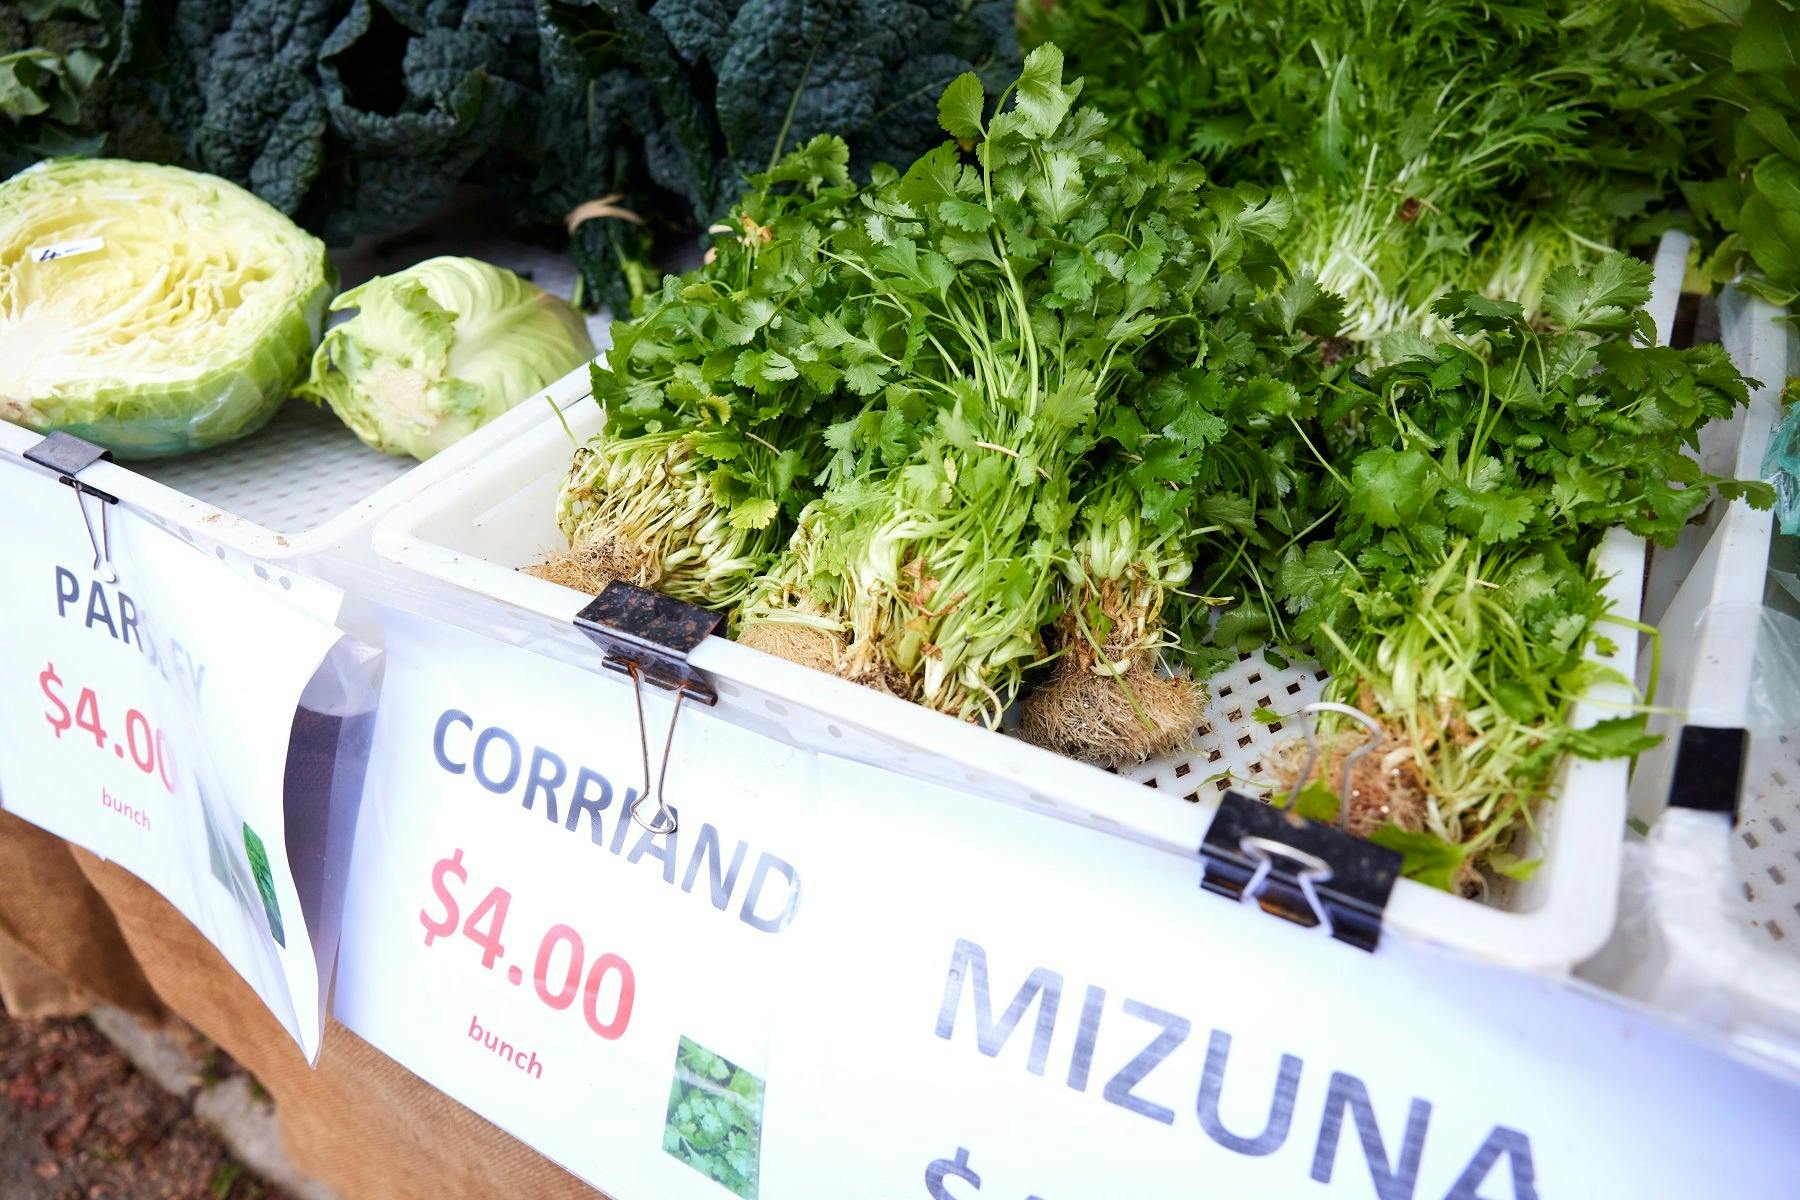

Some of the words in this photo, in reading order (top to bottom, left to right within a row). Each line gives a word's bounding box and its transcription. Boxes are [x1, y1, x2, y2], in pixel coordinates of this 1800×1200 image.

[39, 661, 178, 795] $4.00
[101, 787, 151, 831] bunch
[433, 709, 801, 932] CORRIAND
[420, 849, 635, 1039] $4.00
[467, 1016, 543, 1078] bunch
[934, 938, 1539, 1200] MIZUNA
